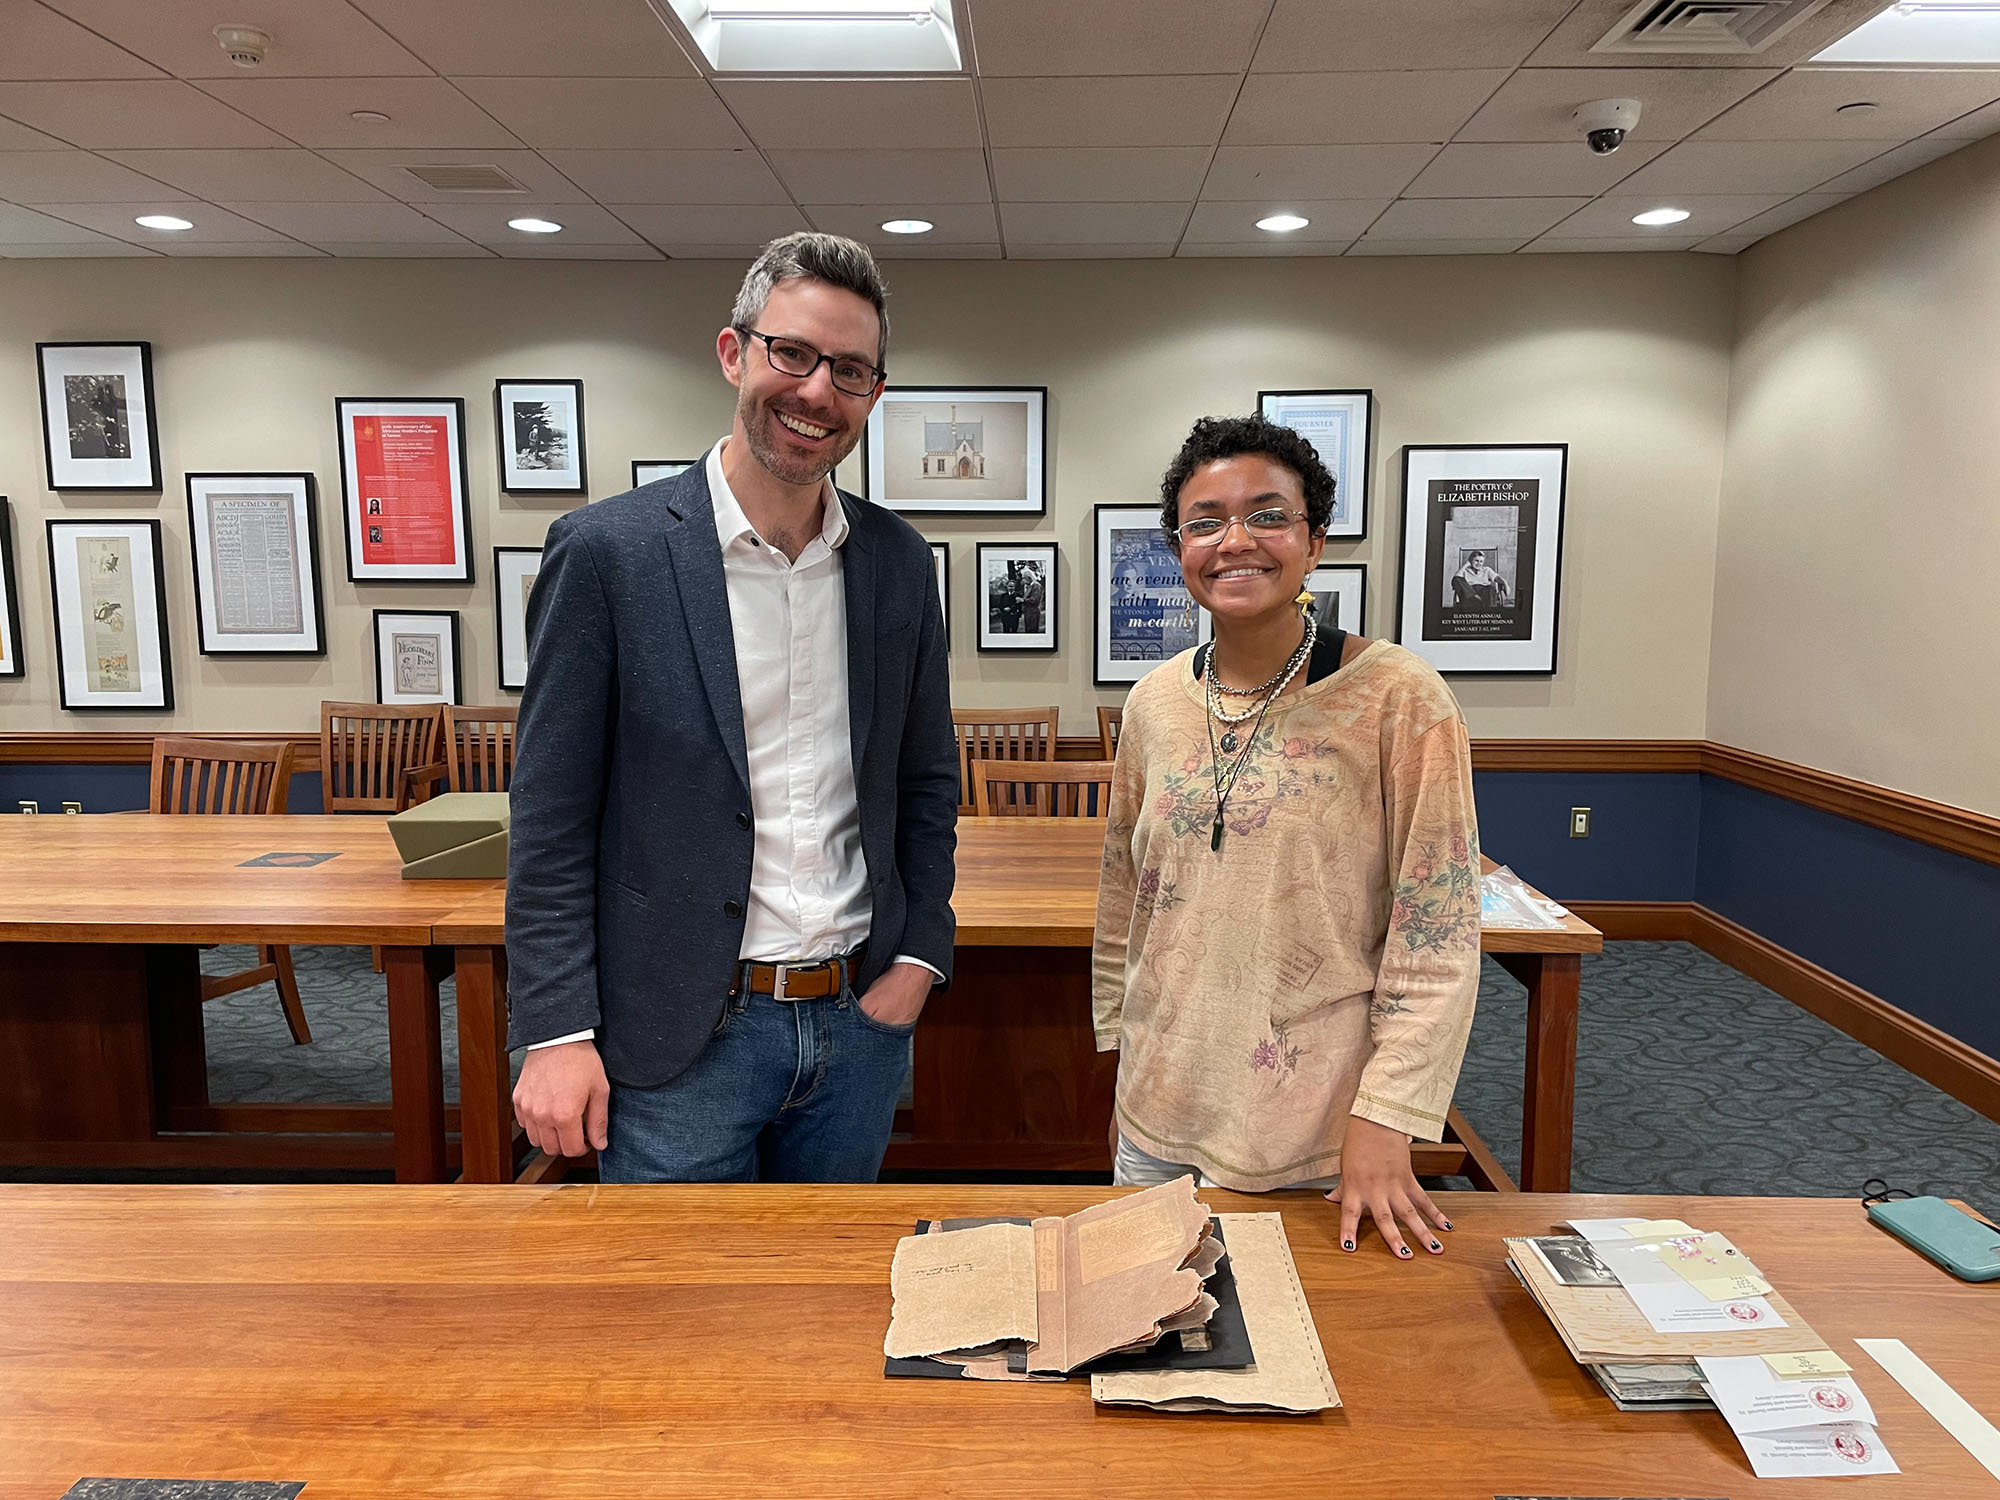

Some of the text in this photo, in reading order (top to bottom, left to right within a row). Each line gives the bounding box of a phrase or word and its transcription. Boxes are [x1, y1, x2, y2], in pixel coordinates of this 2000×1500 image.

[1454, 482, 1514, 491] THE POETRY OF
[1437, 491, 1530, 502] ELIZABETH BISHOP
[1111, 572, 1185, 585] an evenin
[1118, 593, 1149, 607] with
